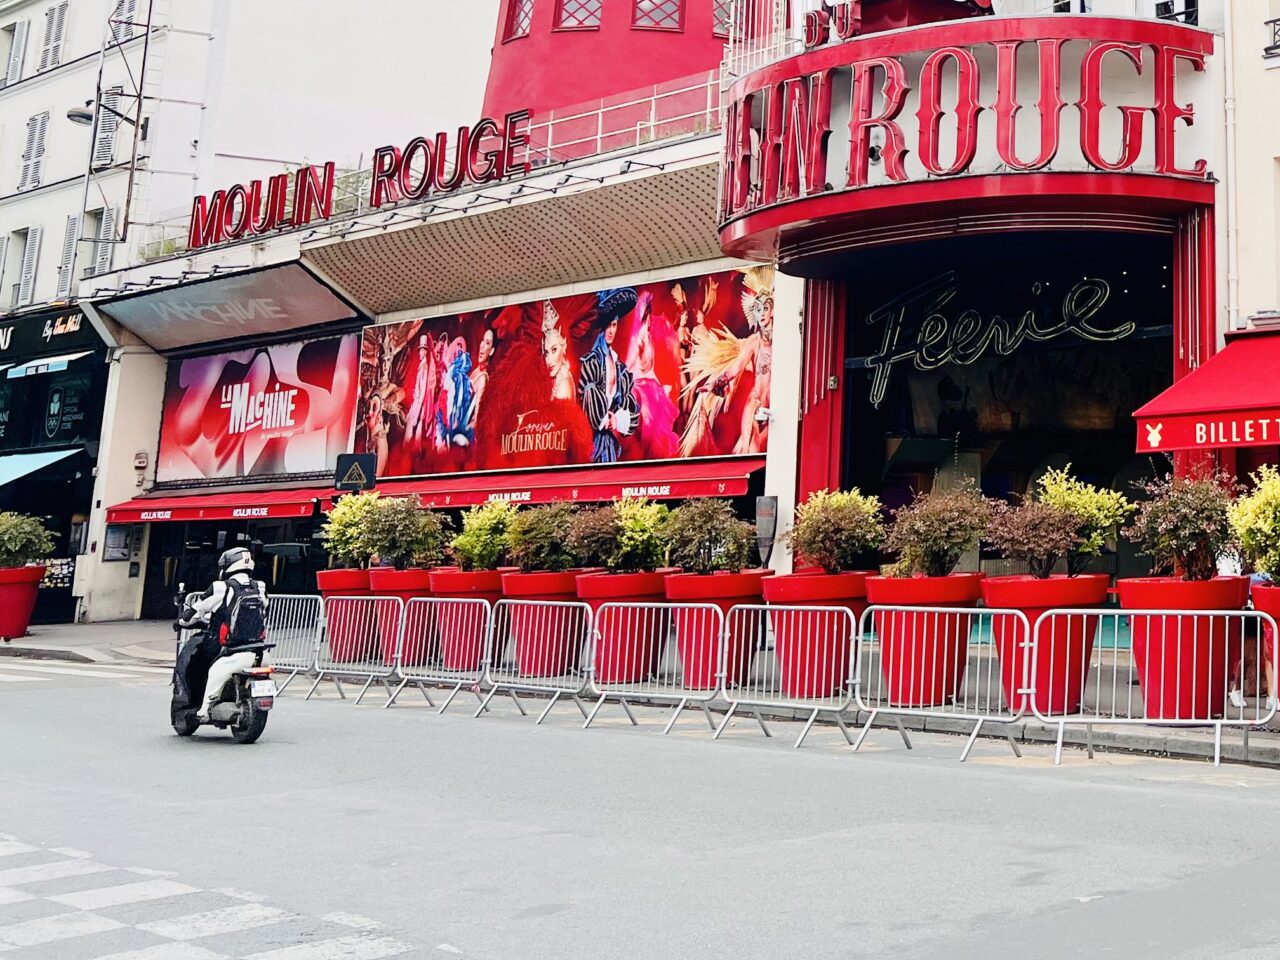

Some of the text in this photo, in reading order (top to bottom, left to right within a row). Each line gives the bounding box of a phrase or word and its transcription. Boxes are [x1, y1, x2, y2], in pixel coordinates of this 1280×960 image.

[847, 39, 1208, 187] ROUGE
[188, 107, 535, 248] MOULIN ROUGE
[511, 409, 556, 434] Forever
[500, 429, 568, 455] MOULIN ROUGE
[622, 485, 671, 497] MOULIN ROUGE
